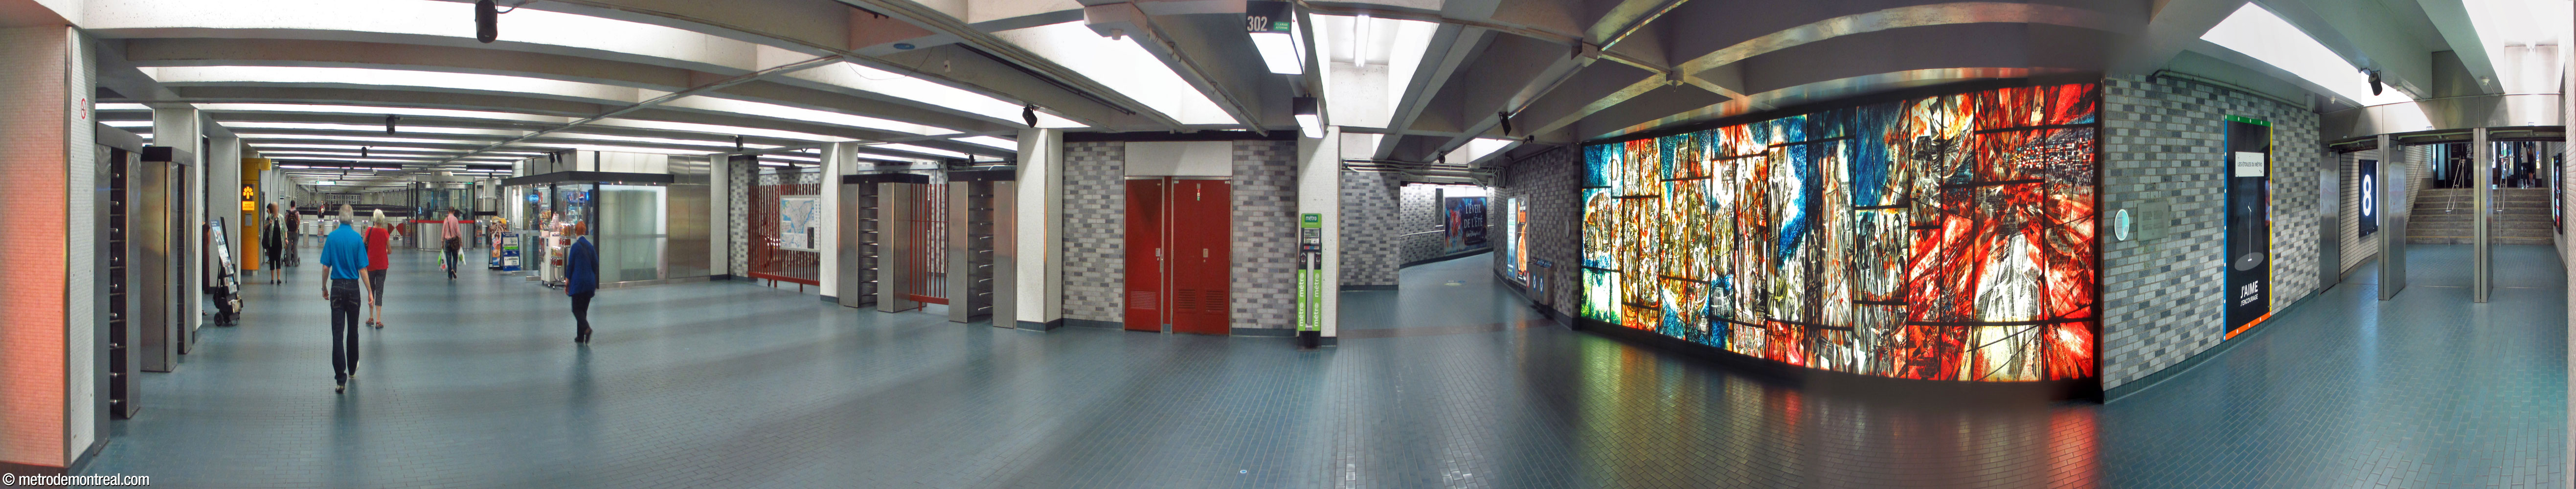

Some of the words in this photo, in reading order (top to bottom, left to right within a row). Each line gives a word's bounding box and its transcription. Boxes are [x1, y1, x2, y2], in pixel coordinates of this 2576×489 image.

[1247, 16, 1267, 31] 302
[2363, 174, 2372, 216] 8
[1466, 202, 1481, 214] L'ÉVEIL
[1464, 219, 1470, 228] DE
[1471, 215, 1483, 227] L'ÉTÉ
[2240, 280, 2258, 299] J'AIME
[2240, 293, 2258, 307] J'ENCOURAGE
